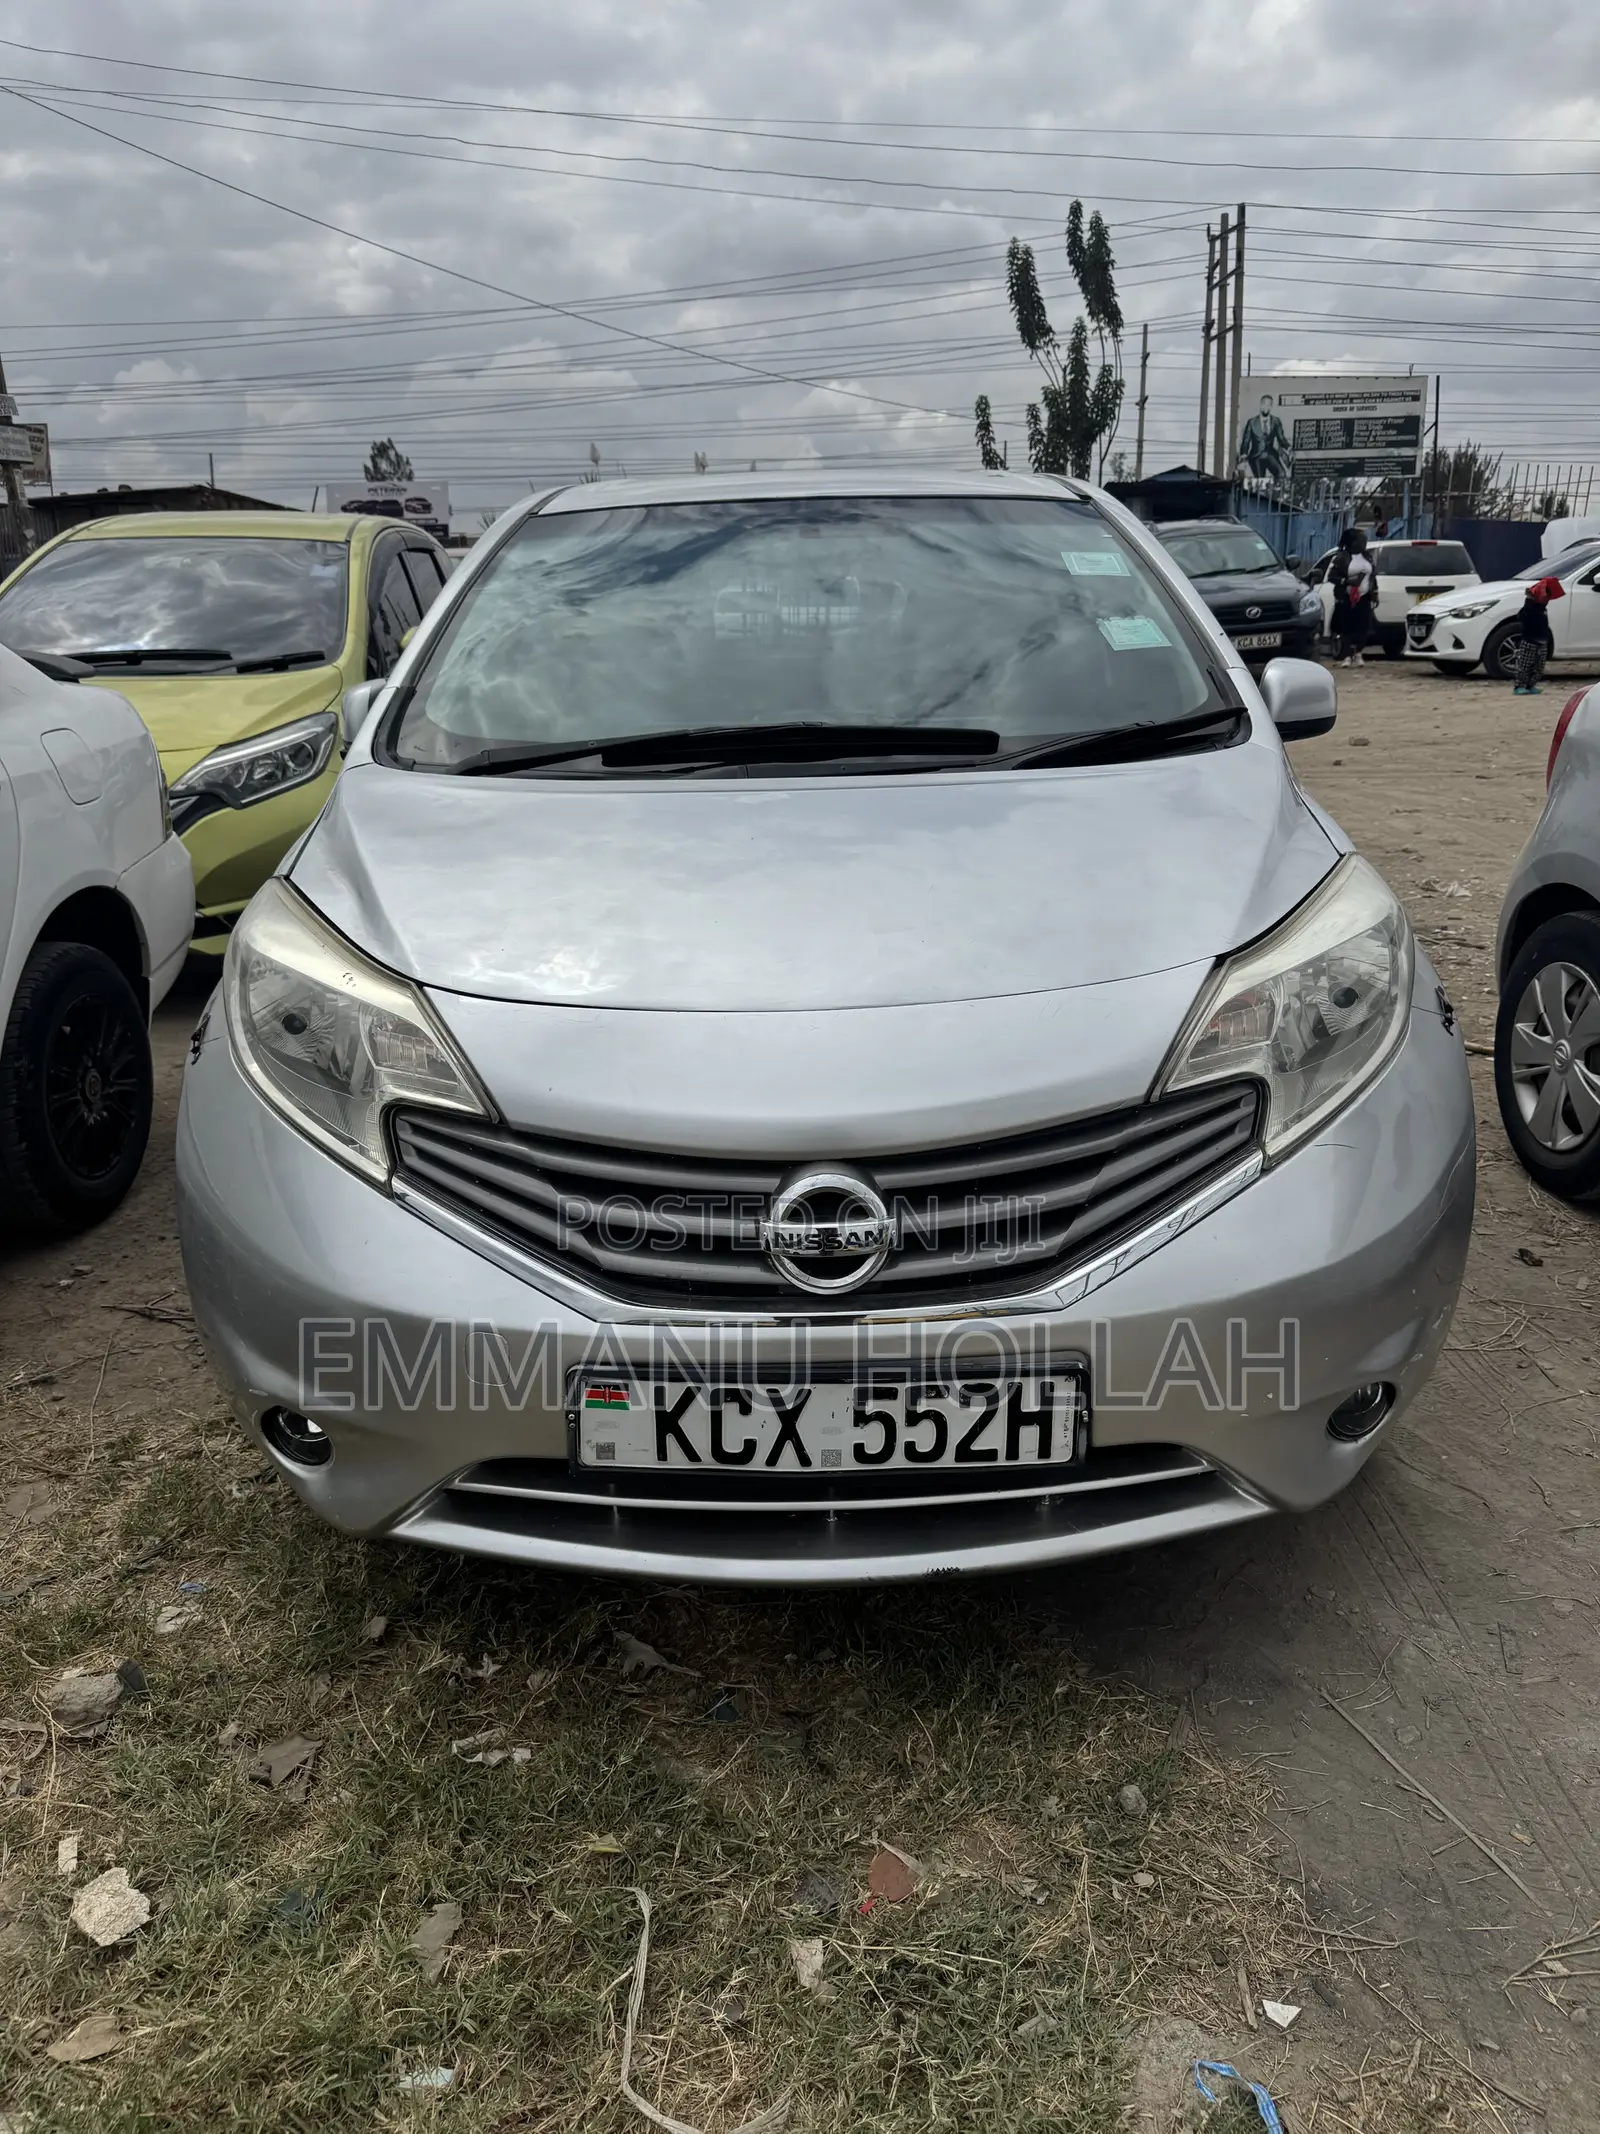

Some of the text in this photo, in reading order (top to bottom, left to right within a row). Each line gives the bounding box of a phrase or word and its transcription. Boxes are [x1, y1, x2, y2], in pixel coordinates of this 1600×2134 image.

[1237, 638, 1254, 648] KCA
[774, 1230, 885, 1251] NISSAN
[655, 1385, 814, 1468] KCX
[853, 1380, 1053, 1467] 552H
